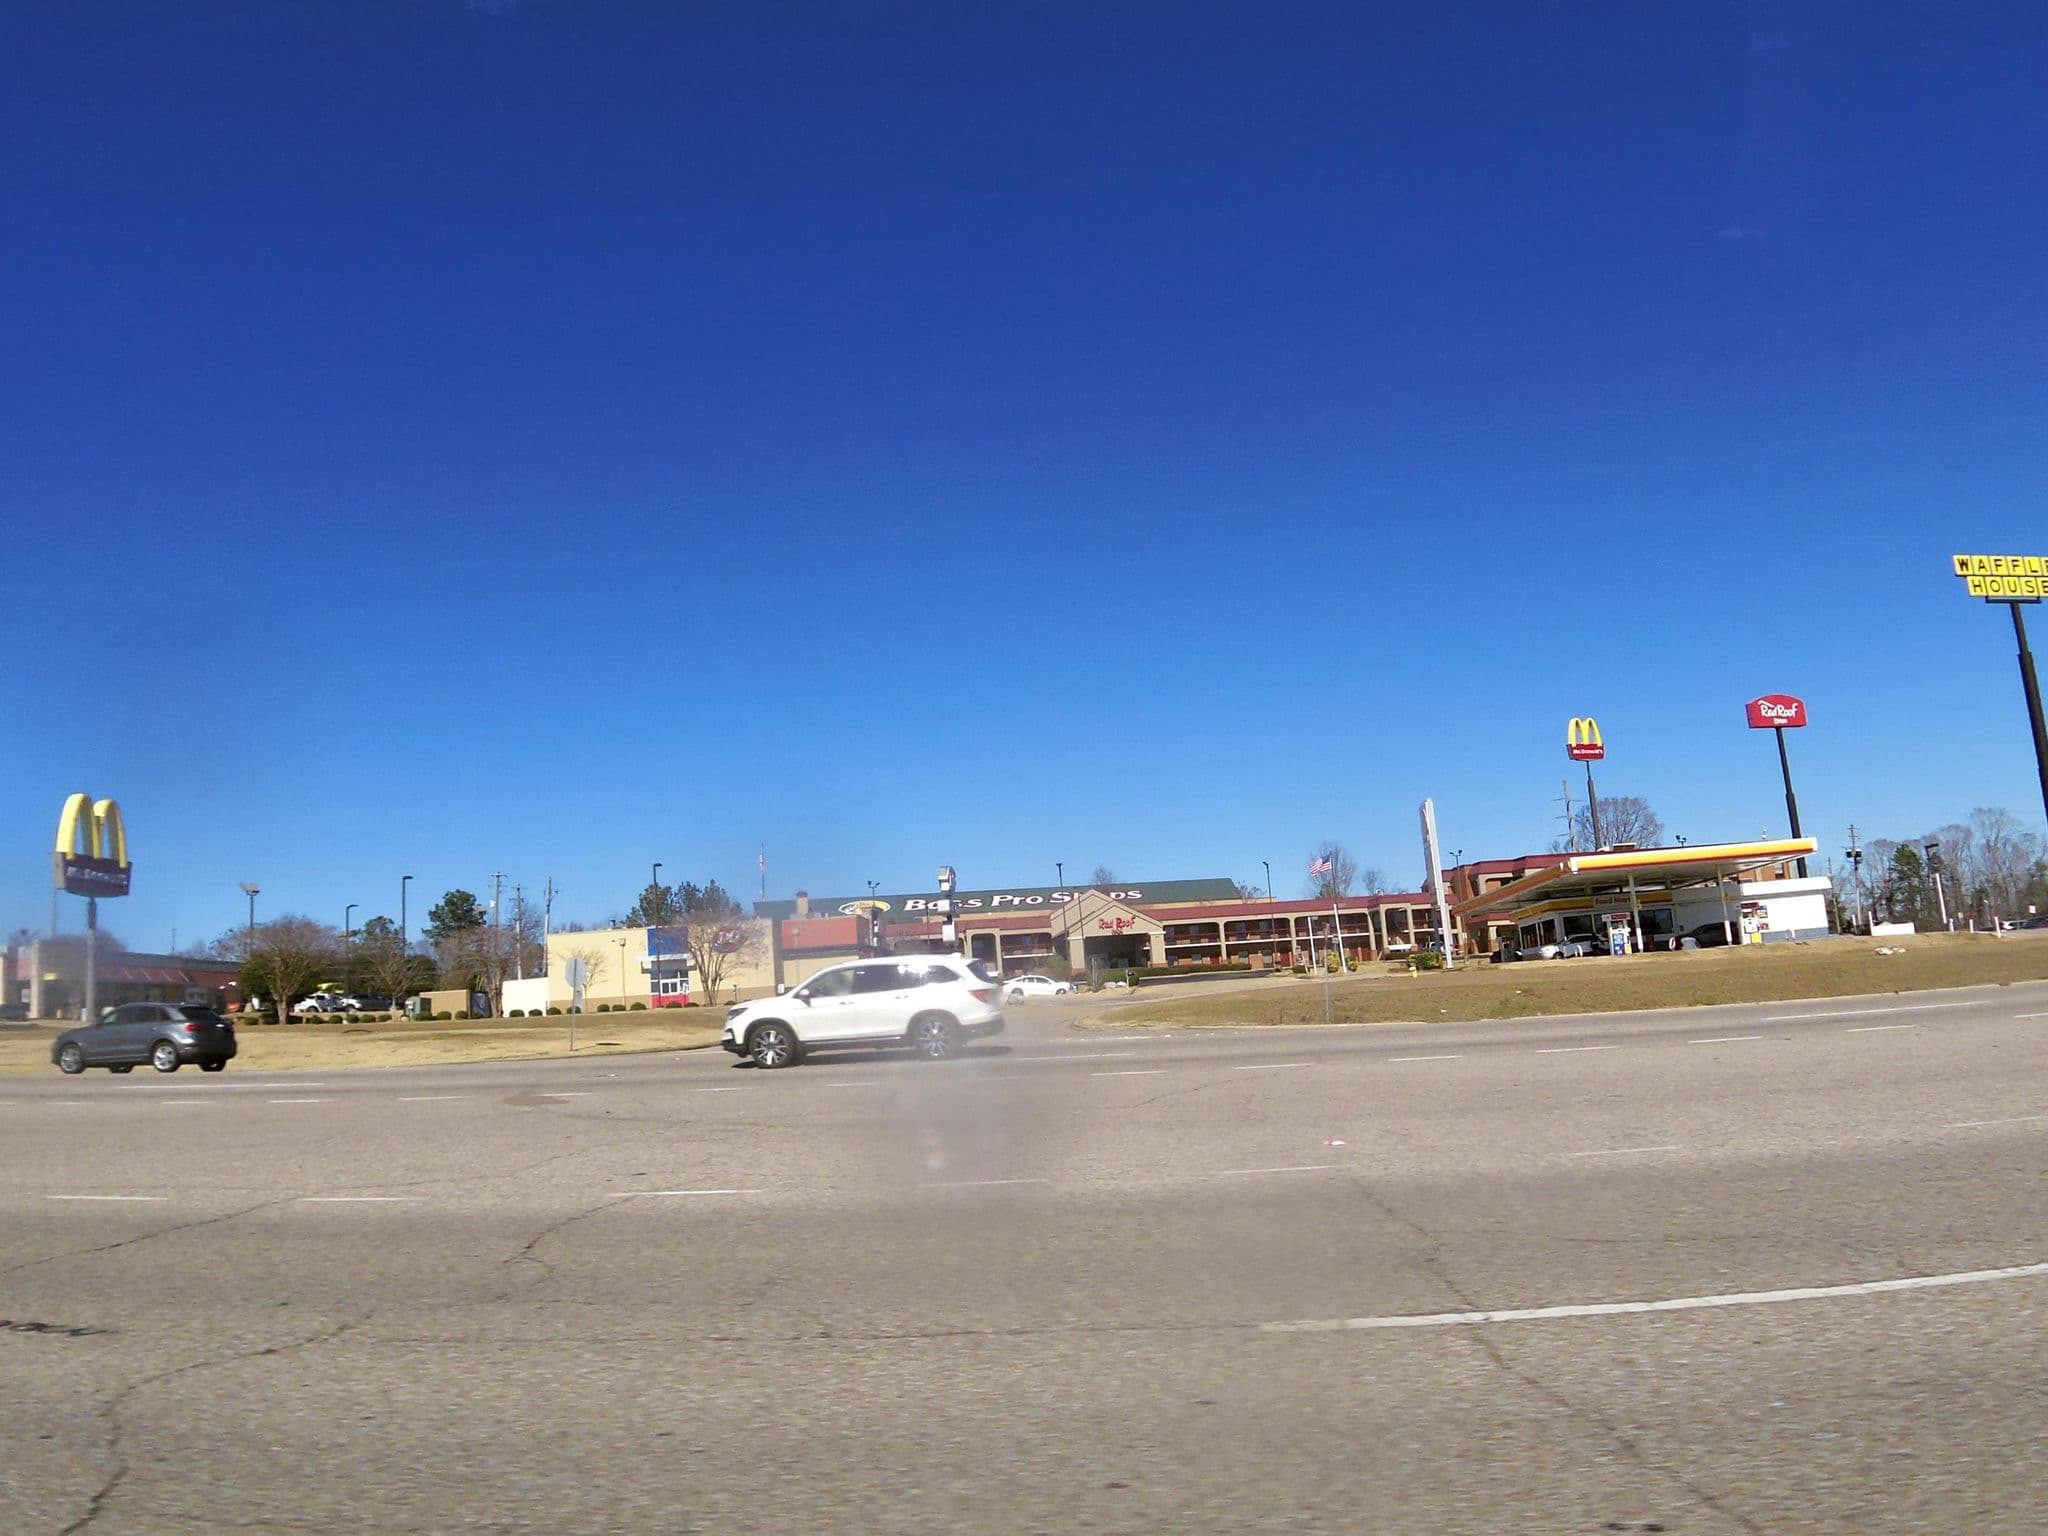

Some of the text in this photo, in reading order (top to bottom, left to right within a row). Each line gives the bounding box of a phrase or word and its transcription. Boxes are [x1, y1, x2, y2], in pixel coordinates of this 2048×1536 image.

[1971, 579, 2048, 594] HOUSE
[1760, 702, 1799, 719] Red Roof
[990, 894, 1044, 908] Pro
